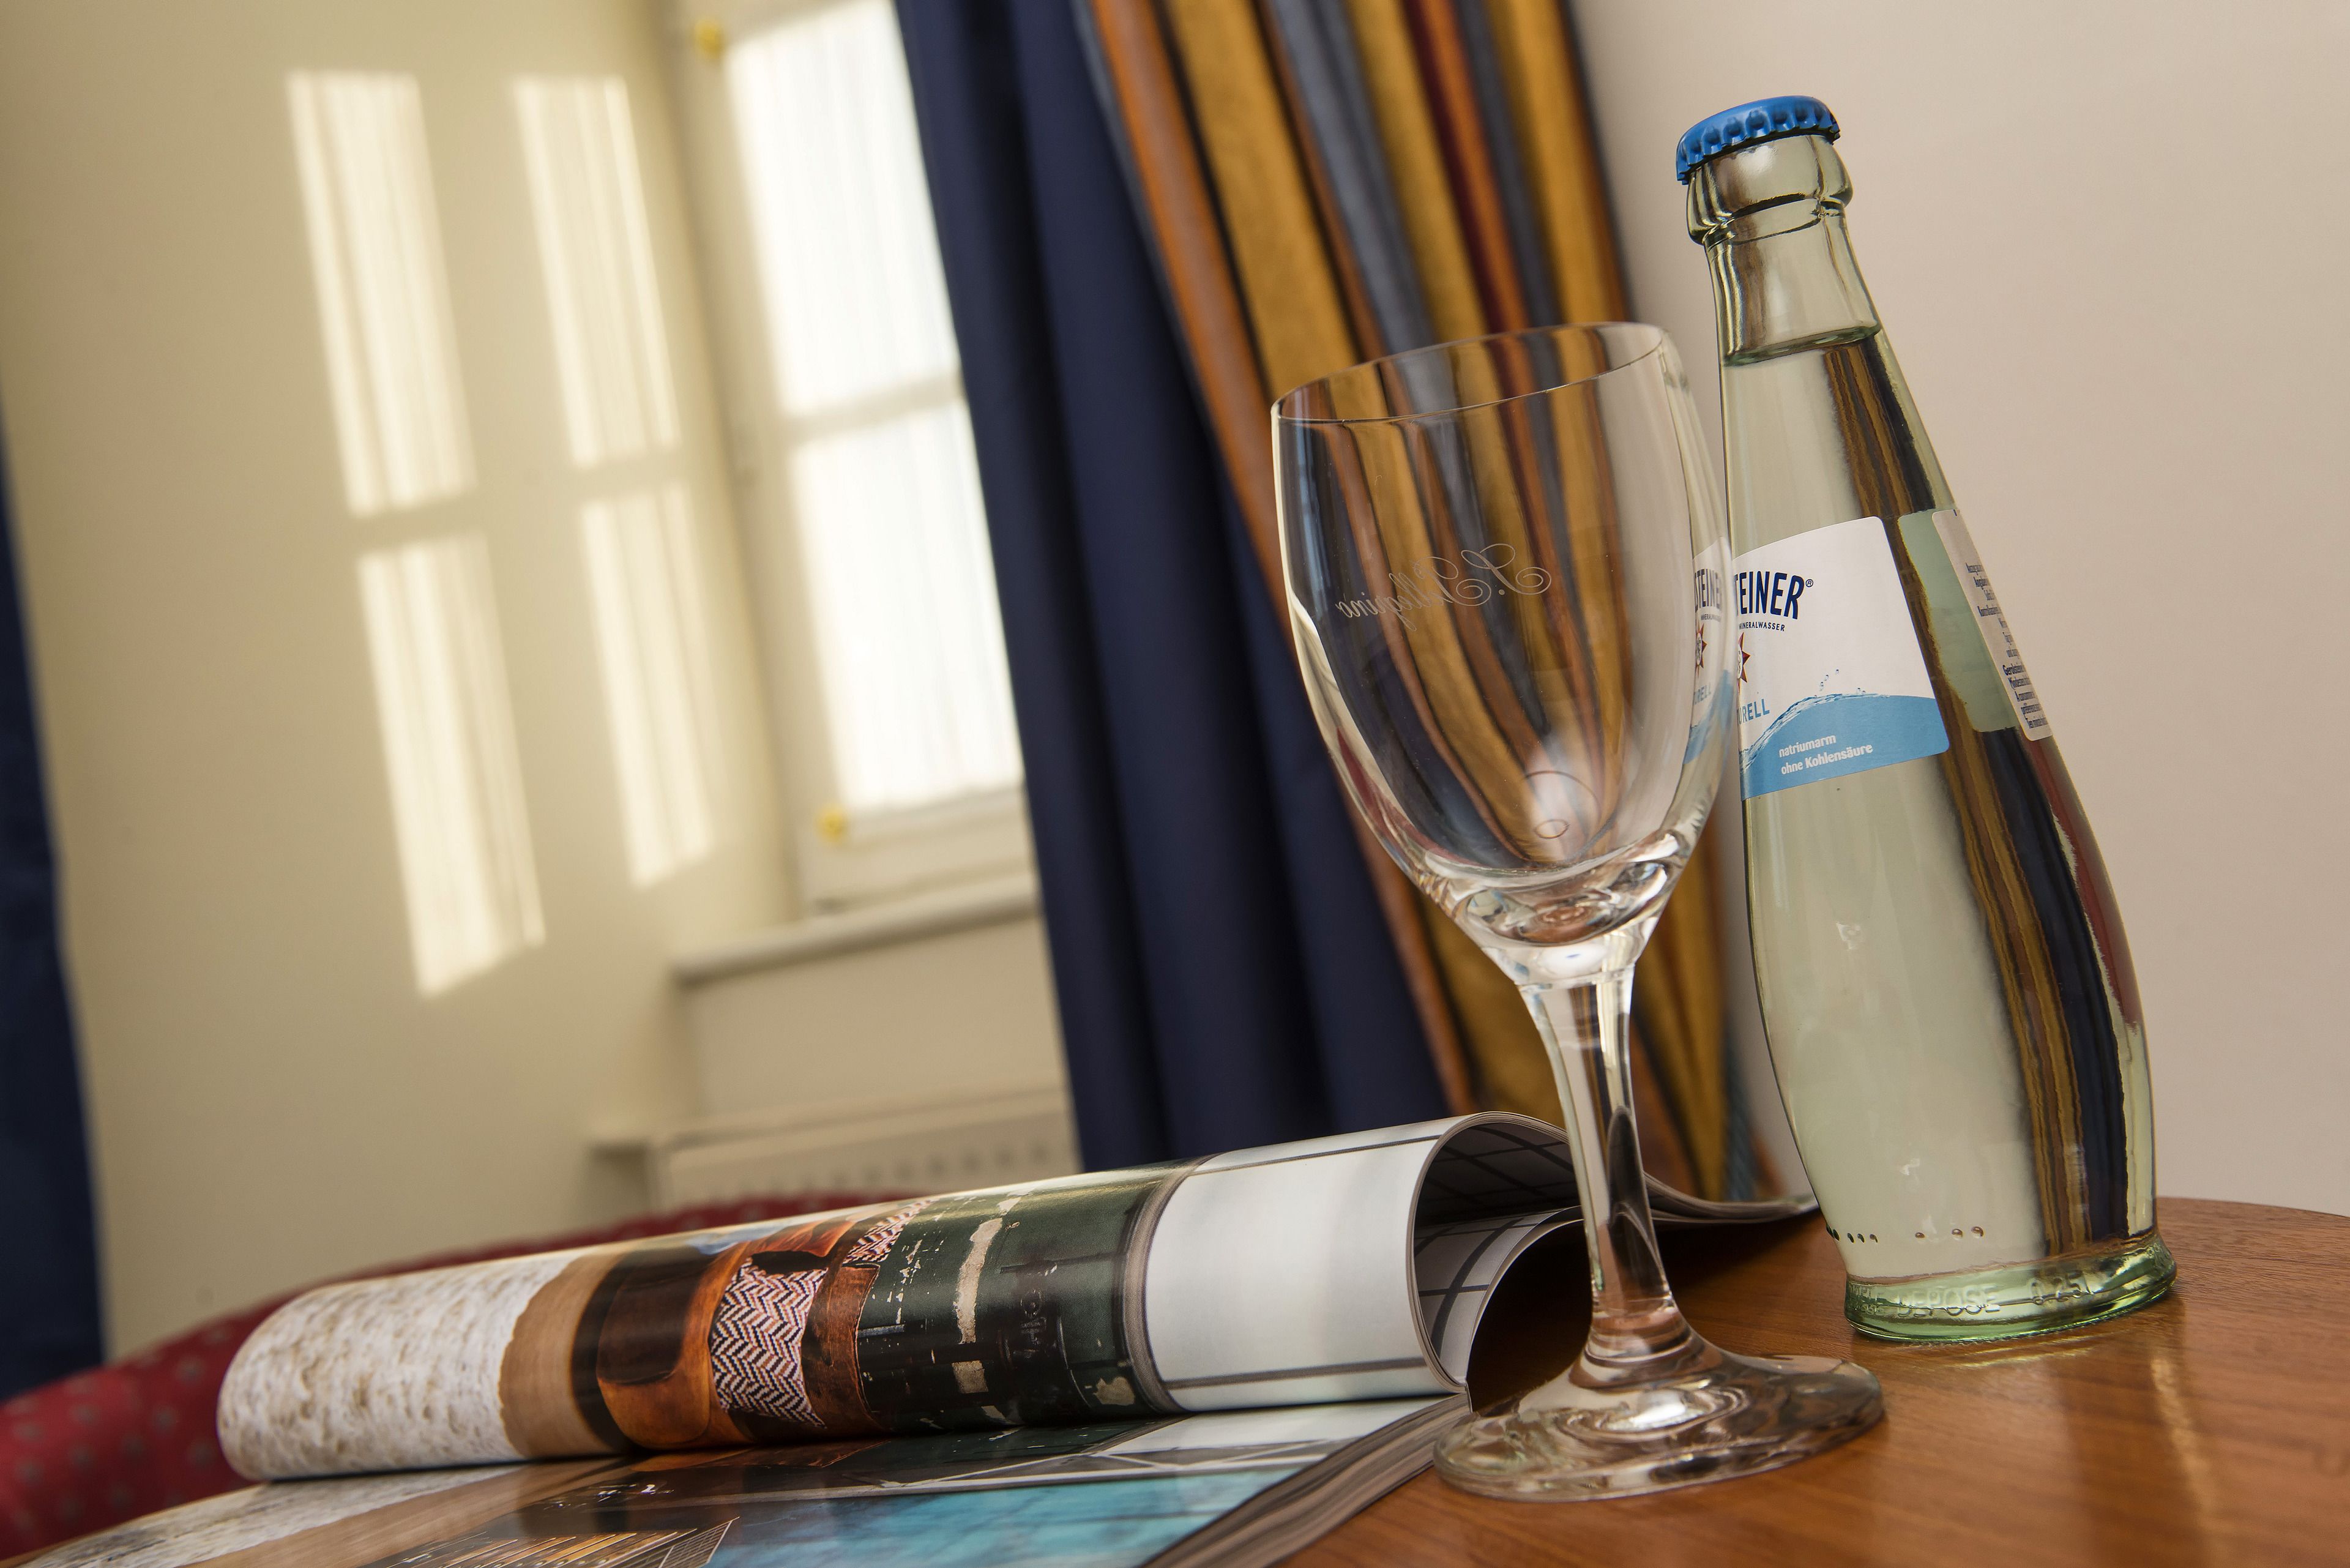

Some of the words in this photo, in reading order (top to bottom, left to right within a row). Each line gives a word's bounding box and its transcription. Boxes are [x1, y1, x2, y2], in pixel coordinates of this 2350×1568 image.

[1779, 735, 1836, 758] natriumarm
[1781, 762, 1804, 775] ohne
[1805, 744, 1873, 769] Kohlensäure
